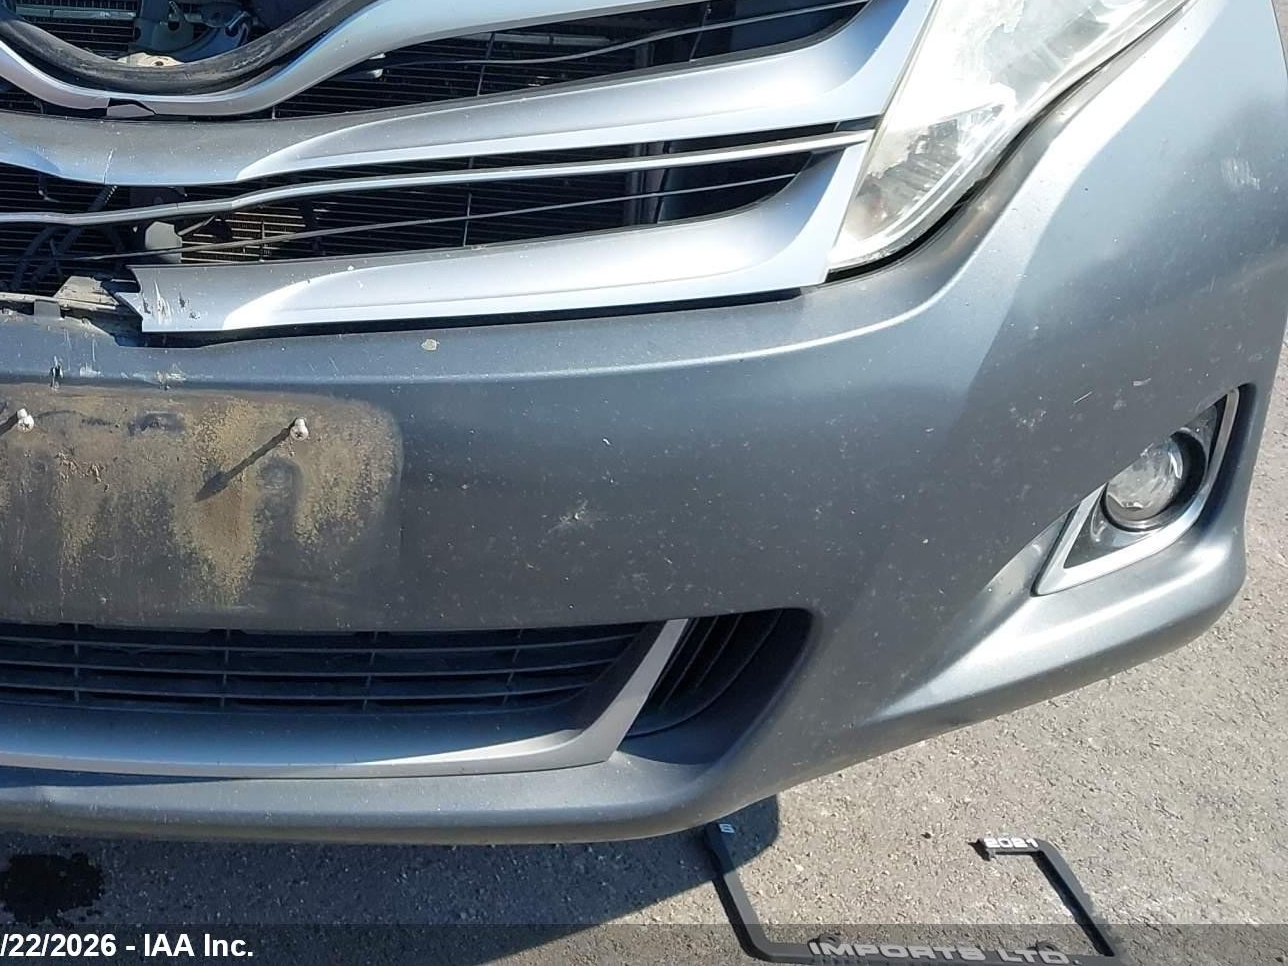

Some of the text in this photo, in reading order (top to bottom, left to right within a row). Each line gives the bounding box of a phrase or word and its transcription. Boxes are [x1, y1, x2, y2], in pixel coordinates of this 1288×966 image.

[983, 837, 1039, 849] 2021
[809, 941, 1079, 965] IMPORTS LTD.
